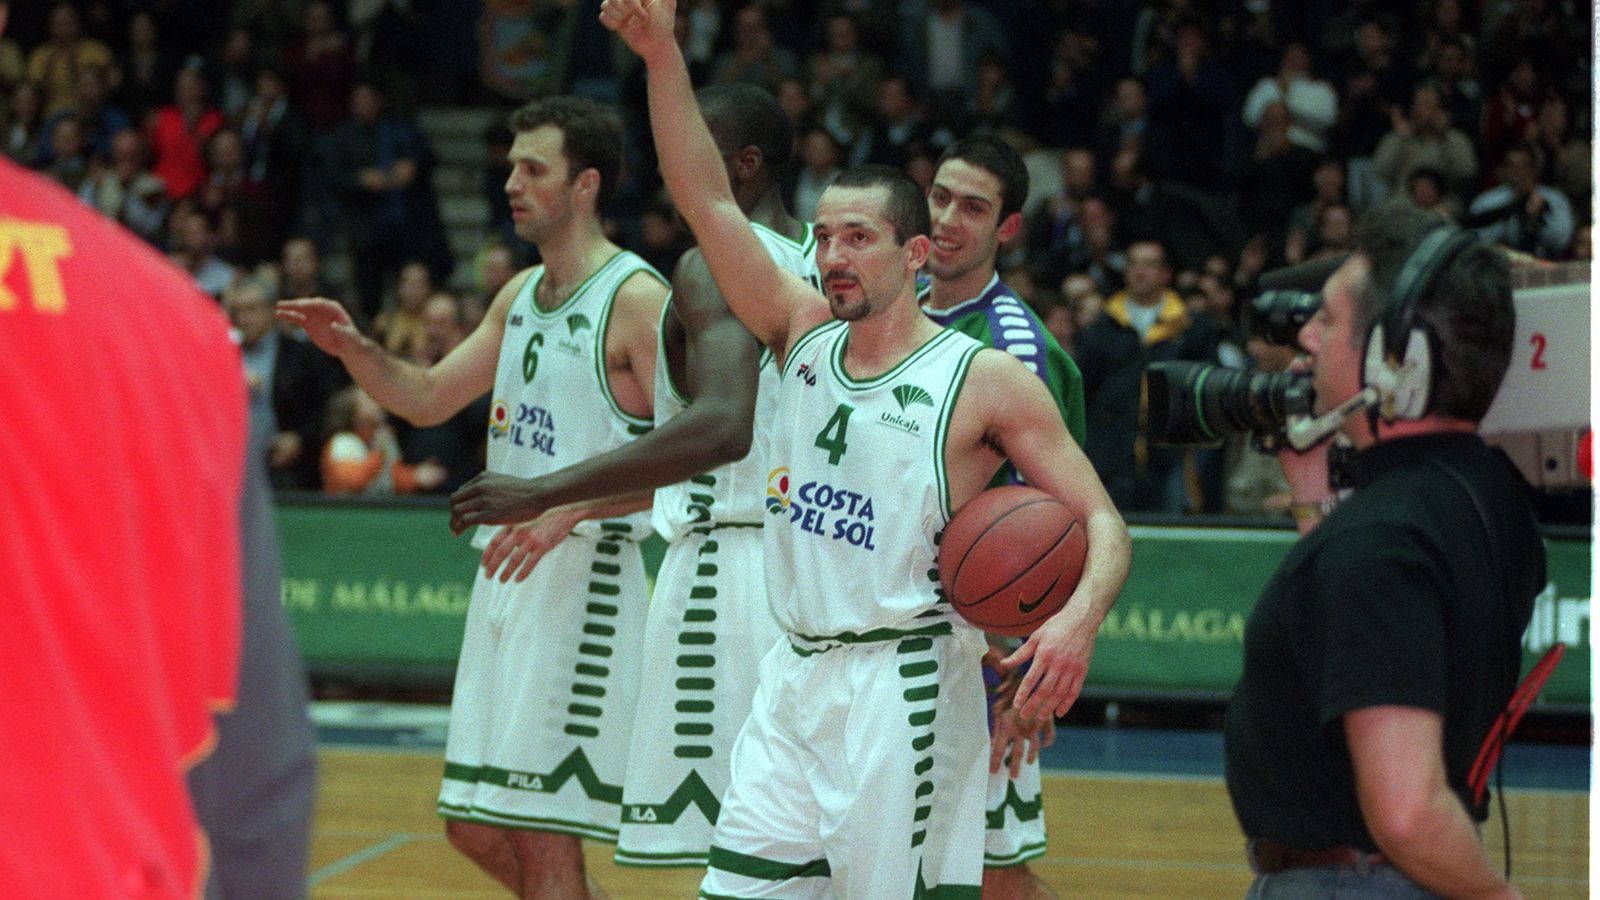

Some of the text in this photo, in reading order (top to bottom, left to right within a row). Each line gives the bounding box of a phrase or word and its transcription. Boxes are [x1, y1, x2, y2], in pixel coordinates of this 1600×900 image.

[522, 332, 544, 385] 6
[1529, 332, 1547, 371] 2
[814, 402, 855, 466] 4
[880, 411, 920, 433] Unicaja
[798, 481, 875, 522] COSTA
[832, 518, 876, 552] SOL
[507, 772, 543, 790] FILA
